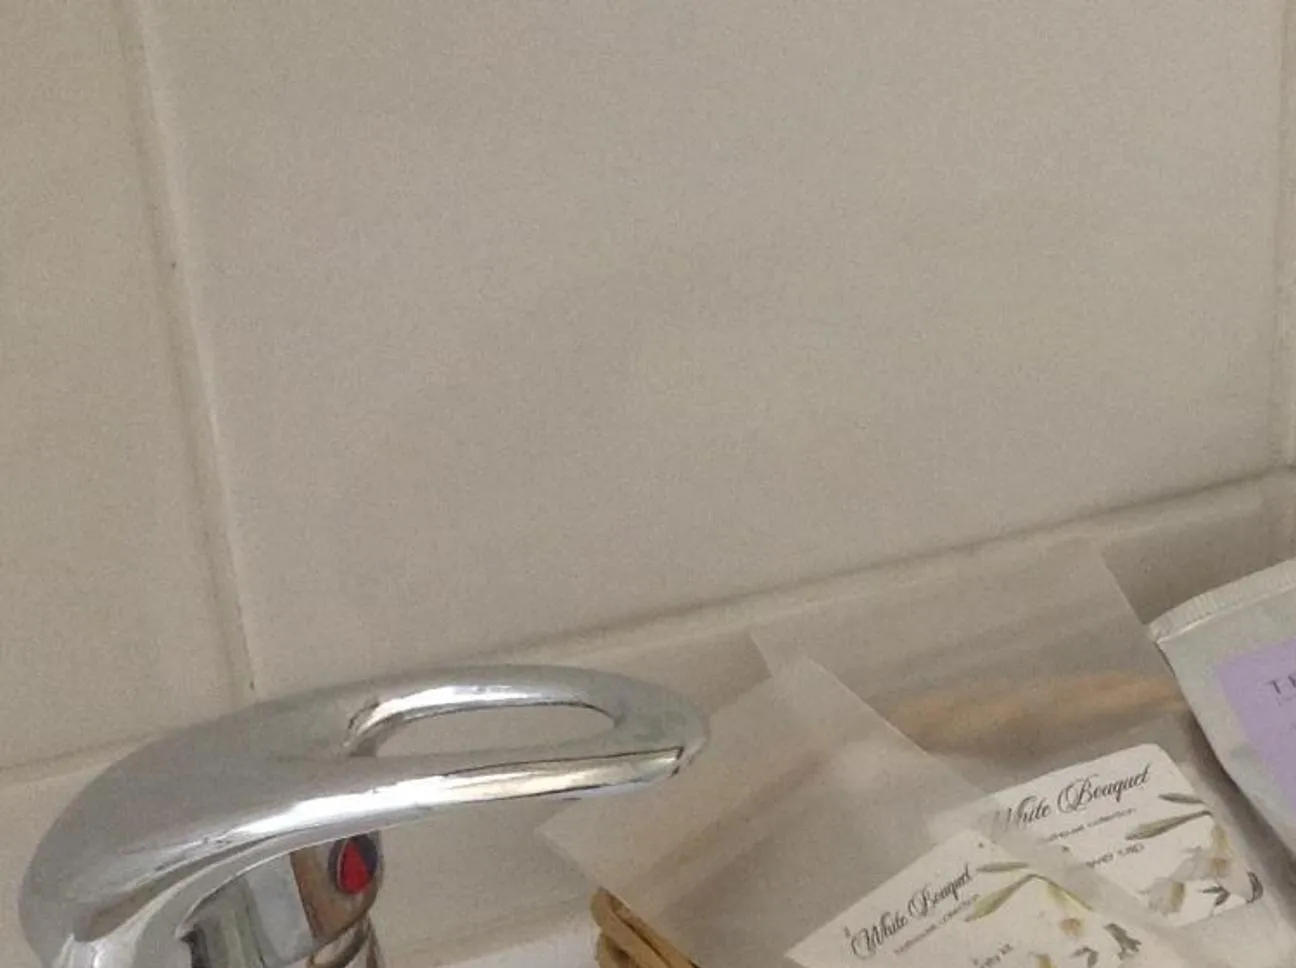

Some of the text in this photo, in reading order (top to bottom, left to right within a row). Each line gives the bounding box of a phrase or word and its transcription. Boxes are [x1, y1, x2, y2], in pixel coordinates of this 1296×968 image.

[1057, 761, 1151, 813] Bouquet
[850, 911, 908, 960] White
[908, 863, 973, 919] Bouquet
